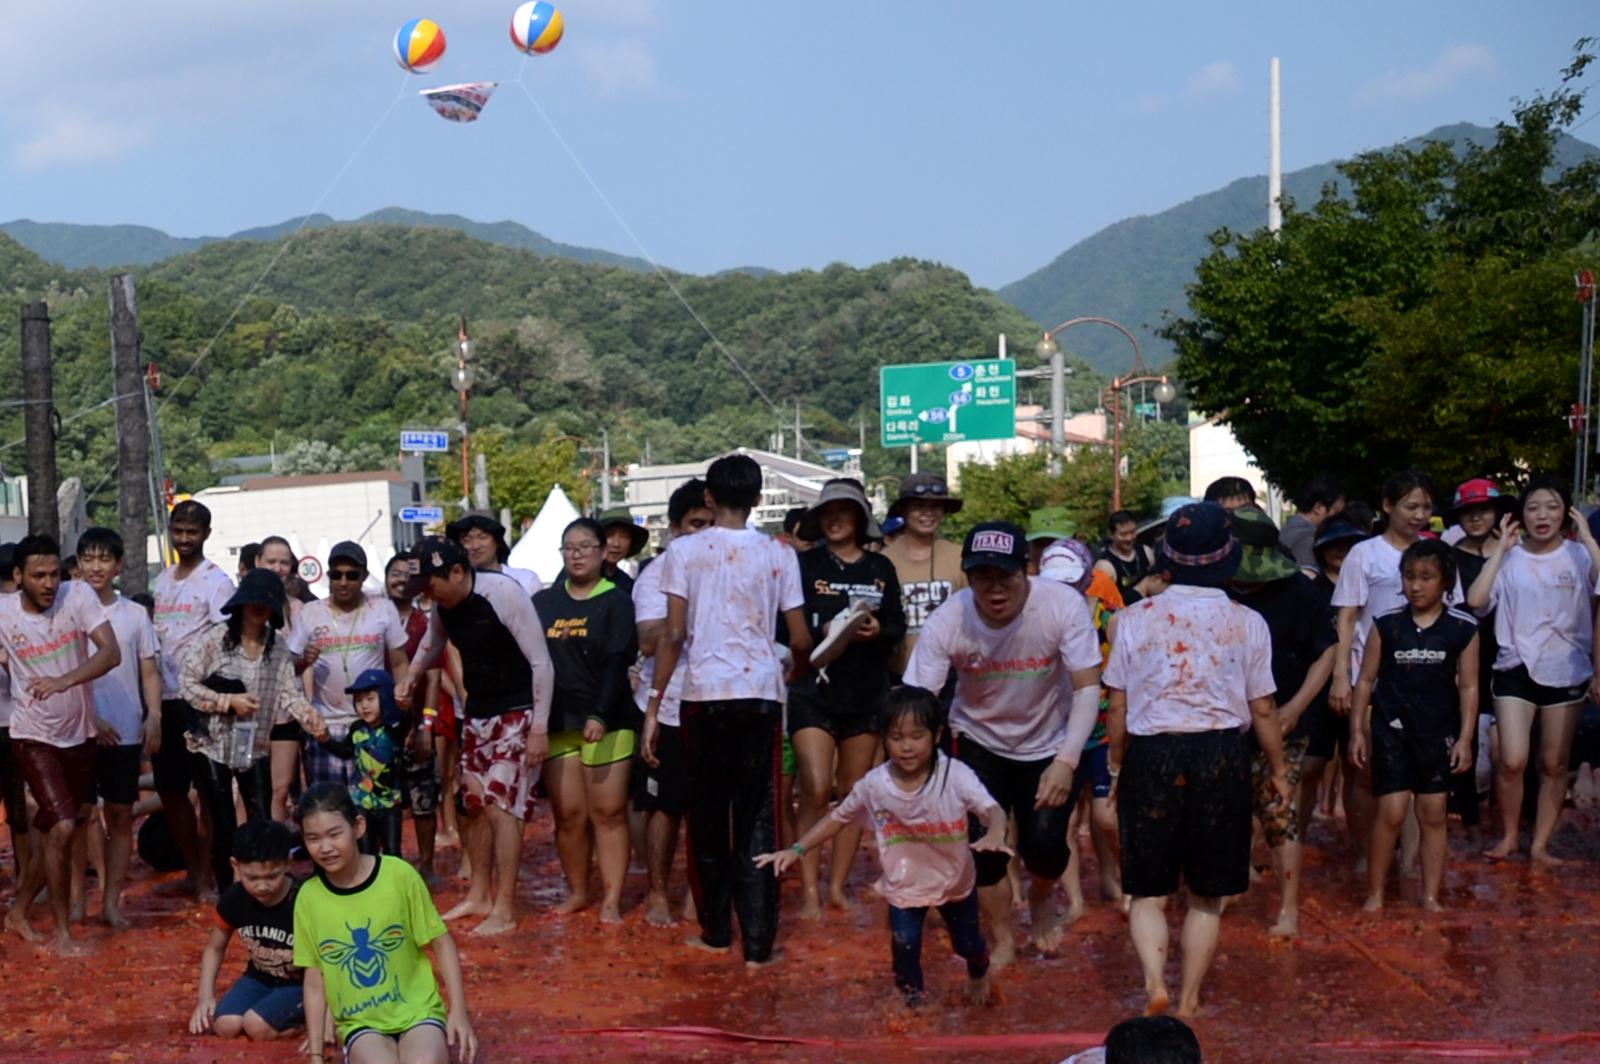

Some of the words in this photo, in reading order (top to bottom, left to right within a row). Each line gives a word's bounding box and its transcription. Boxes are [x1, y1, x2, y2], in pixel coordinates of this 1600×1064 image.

[957, 367, 966, 377] 5
[975, 534, 1010, 551] TEXAS
[303, 563, 317, 577] 30
[1393, 647, 1447, 660] adidas
[255, 924, 287, 943] LAND
